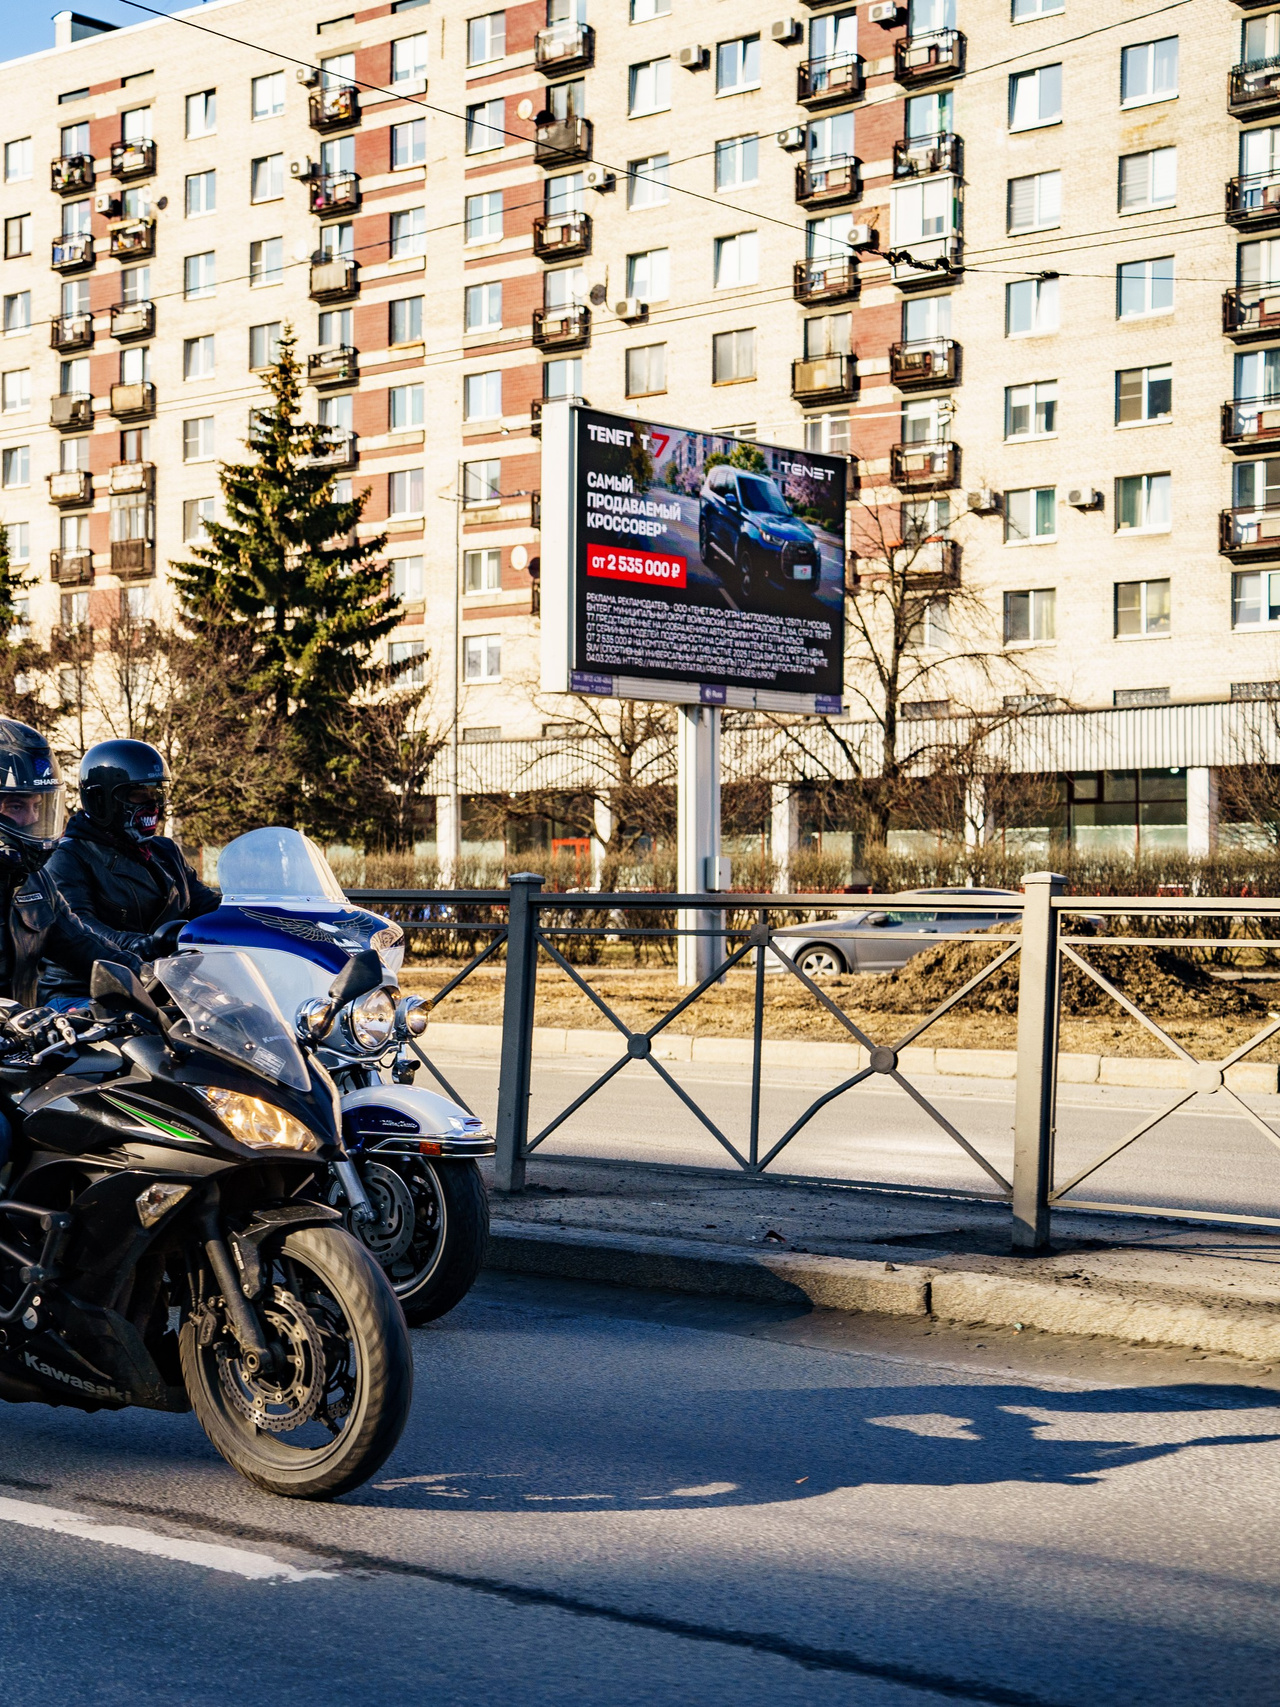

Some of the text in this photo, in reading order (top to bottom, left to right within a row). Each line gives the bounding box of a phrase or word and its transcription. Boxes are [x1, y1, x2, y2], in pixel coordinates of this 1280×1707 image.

[587, 424, 634, 447] TENET
[780, 461, 835, 481] TENET
[587, 471, 634, 494] САМЫЙ
[587, 492, 681, 521] ПРОДАВАЕМЫЙ
[592, 554, 680, 578] от 2 535 000 ₽
[586, 622, 595, 632] ОТ
[586, 633, 595, 642] ОТ
[596, 634, 600, 643] 2
[601, 634, 613, 644] 535
[615, 636, 627, 646] 000
[586, 642, 599, 653] SUV
[170, 1119, 200, 1136] 650
[24, 1351, 132, 1403] Kawasaki
